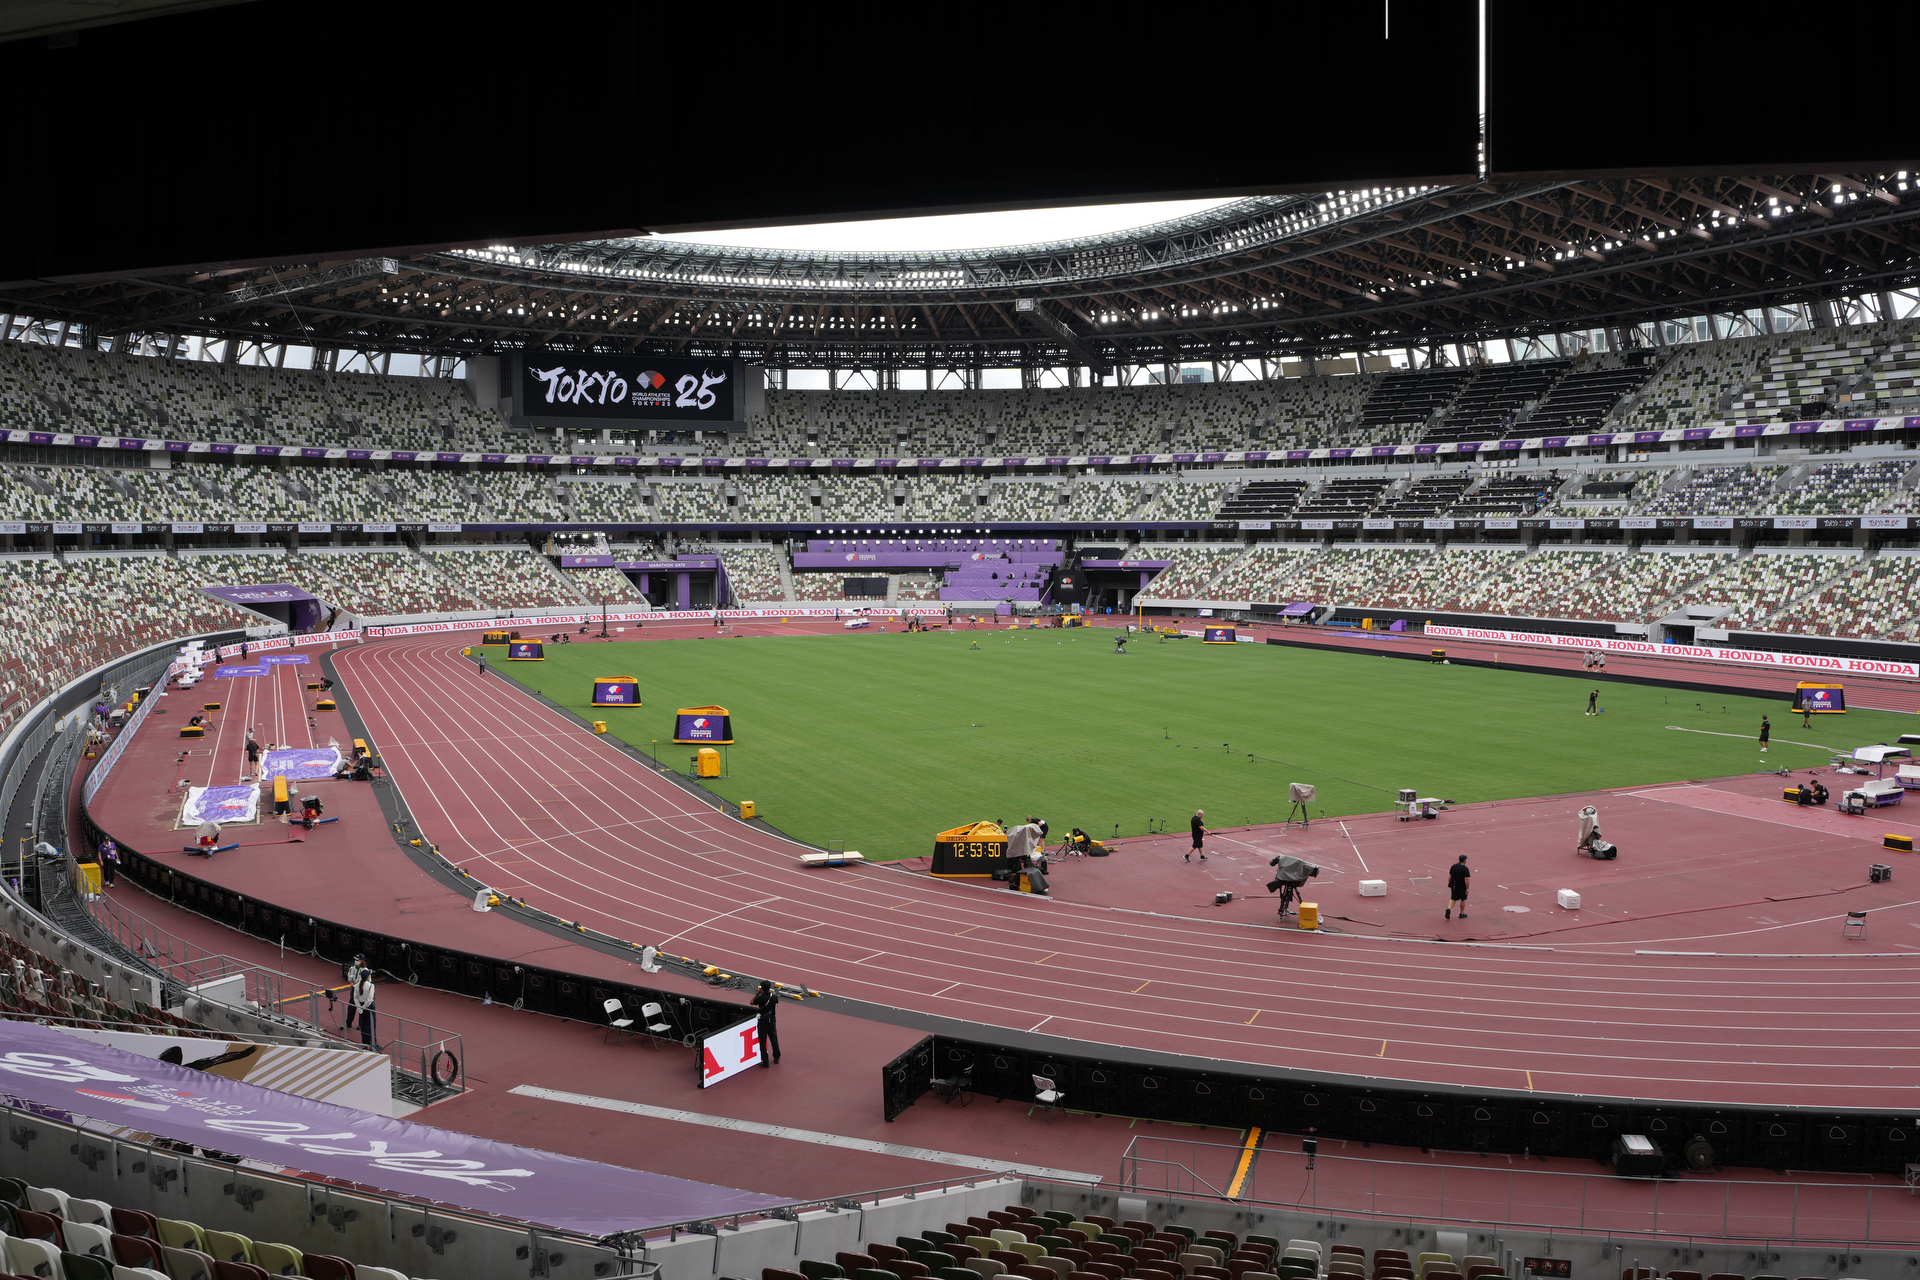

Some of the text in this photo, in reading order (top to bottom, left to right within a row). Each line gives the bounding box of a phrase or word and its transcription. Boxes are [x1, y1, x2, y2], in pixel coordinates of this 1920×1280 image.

[529, 366, 727, 410] TOKYO 25
[369, 627, 409, 635] HONDA
[412, 624, 450, 633] HONDA
[453, 621, 491, 630] HONDA
[495, 619, 534, 627] HONDA
[536, 616, 576, 624] HONDA
[625, 612, 666, 620] HONDA
[298, 633, 332, 645] HONDA
[1426, 626, 1916, 676] HONDA HONDA HONDA HONDA HONDA HONDA HONDA HONDA HONDA
[953, 843, 1000, 857] 12:53:50
